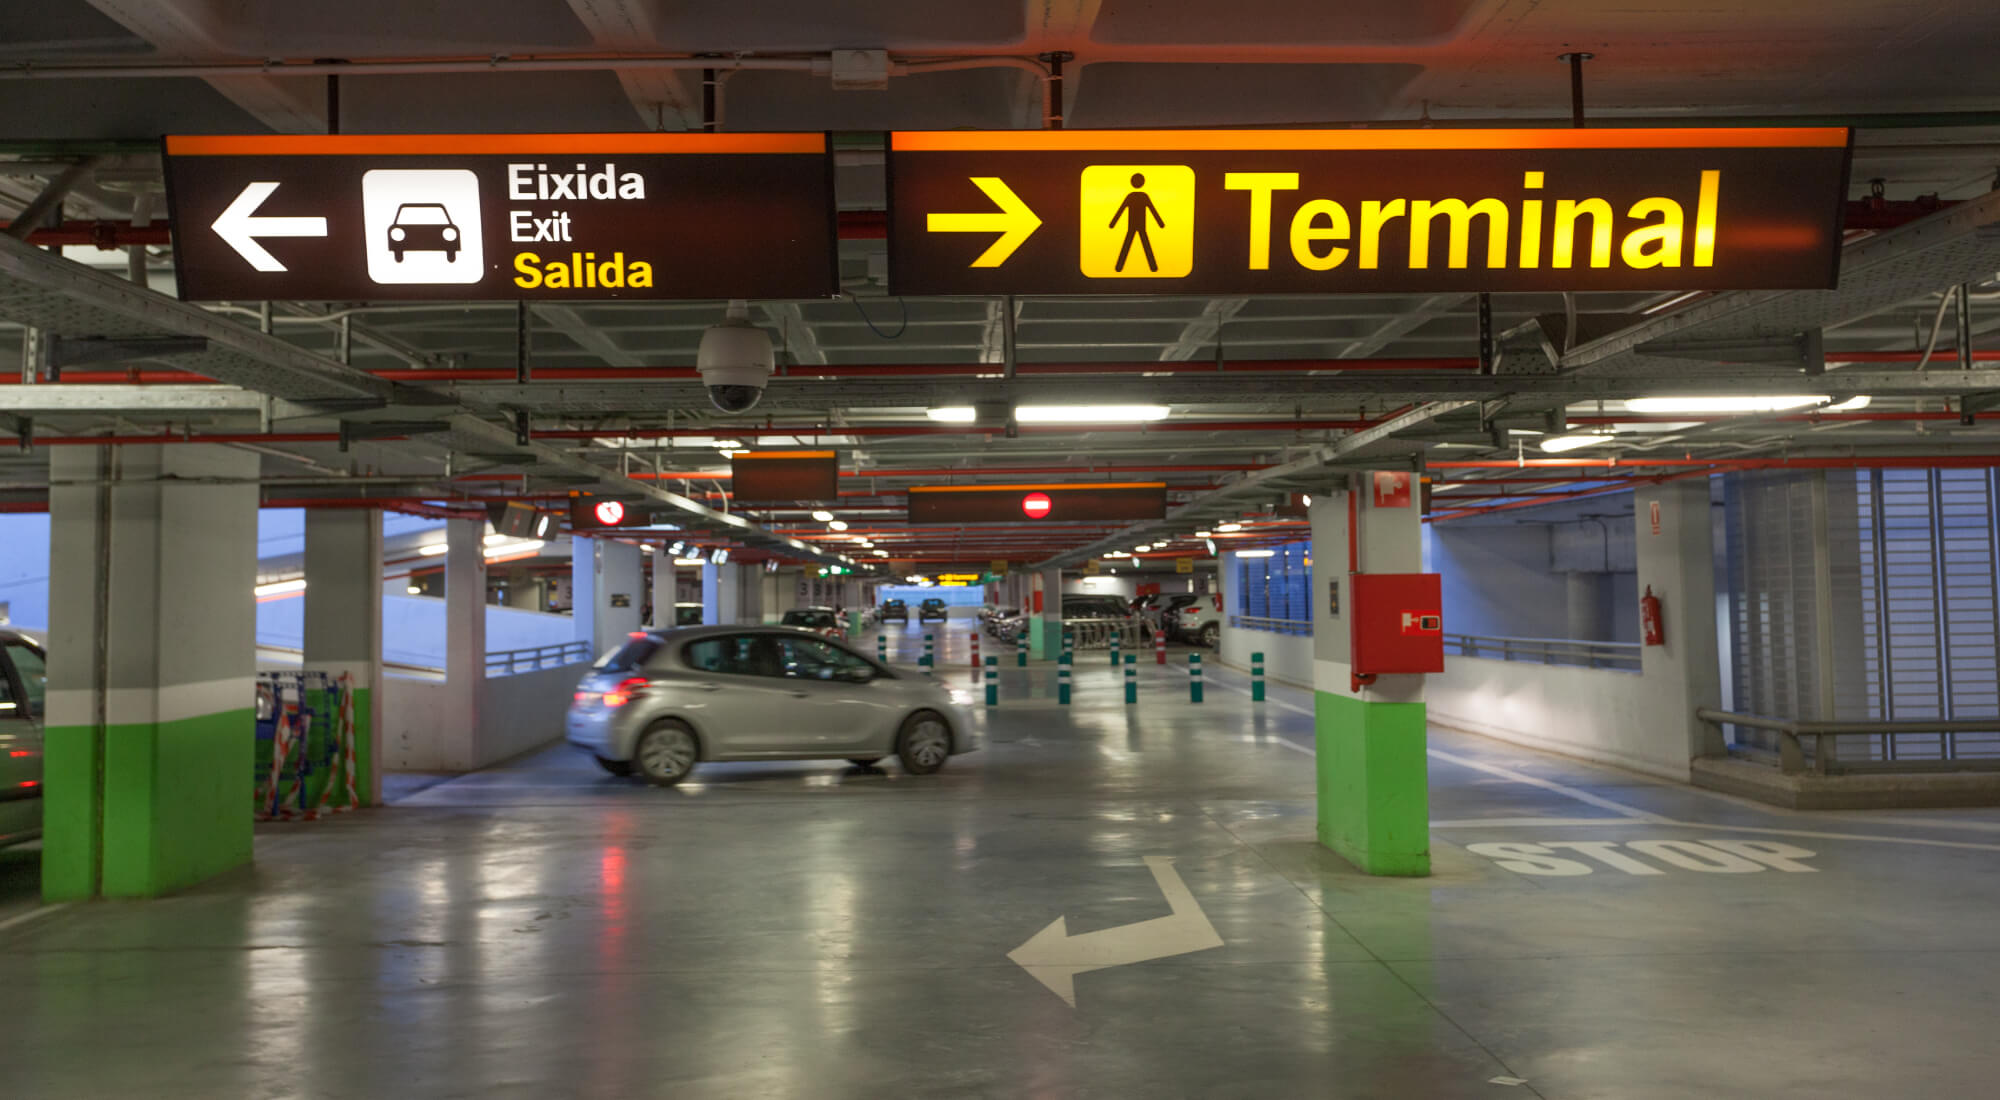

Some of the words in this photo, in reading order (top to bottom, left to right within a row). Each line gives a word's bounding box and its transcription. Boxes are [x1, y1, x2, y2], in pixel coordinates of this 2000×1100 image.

[508, 163, 645, 200] Eixida
[510, 210, 572, 242] Exit
[1224, 170, 1720, 271] Terminal
[513, 251, 653, 289] Salida
[1466, 839, 1820, 876] STOP
